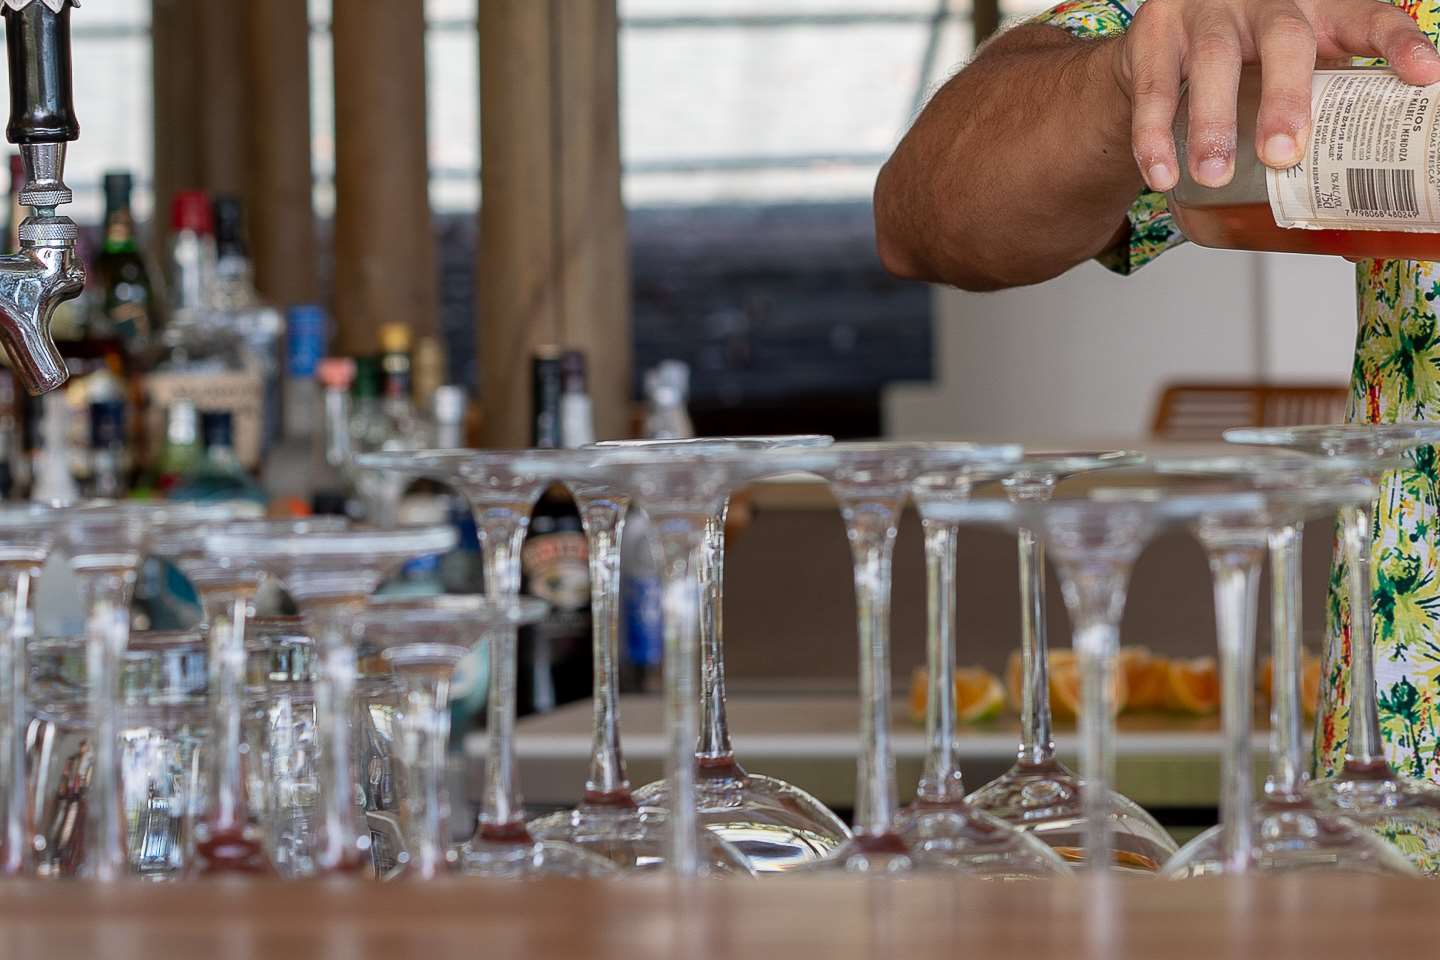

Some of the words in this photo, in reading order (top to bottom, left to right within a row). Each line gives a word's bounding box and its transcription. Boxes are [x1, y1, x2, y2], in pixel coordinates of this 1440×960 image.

[1404, 98, 1419, 122] MALBEC
[1412, 97, 1429, 132] CRIOS
[1399, 128, 1411, 162] MENDOZA
[1428, 150, 1436, 185] FRESCAS
[1344, 209, 1351, 217] 7
